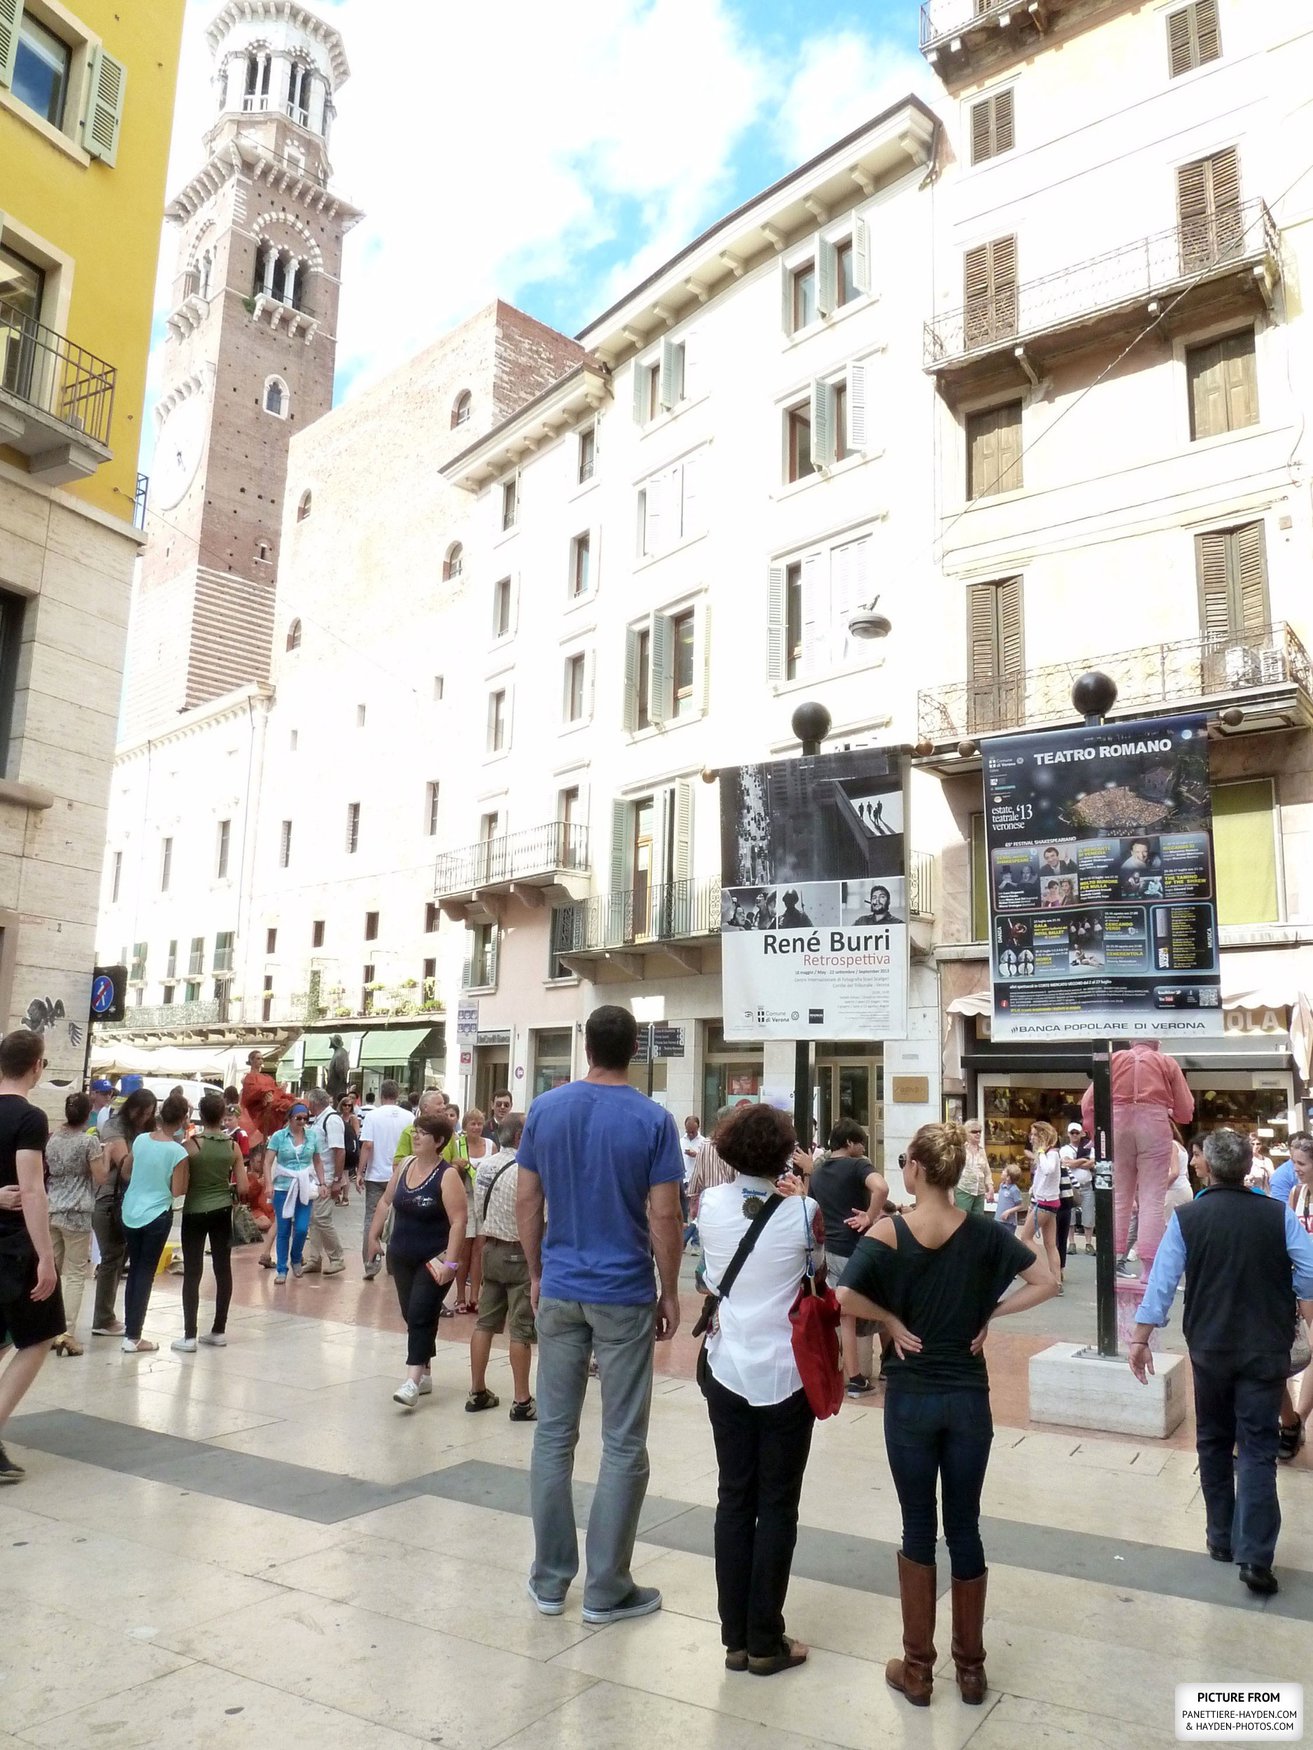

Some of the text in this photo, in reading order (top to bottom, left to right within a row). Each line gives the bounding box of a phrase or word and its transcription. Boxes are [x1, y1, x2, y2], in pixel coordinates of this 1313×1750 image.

[1034, 739, 1172, 765] TEATRO ROMANO
[991, 806, 1013, 815] estate
[992, 811, 1019, 823] teatrale
[992, 821, 1025, 831] veronese
[764, 929, 890, 954] René Burri
[804, 953, 890, 968] Retrospettiva
[1227, 1011, 1280, 1030] OLA
[1019, 1022, 1206, 1033] BANCA POPOLARE DI VERONA
